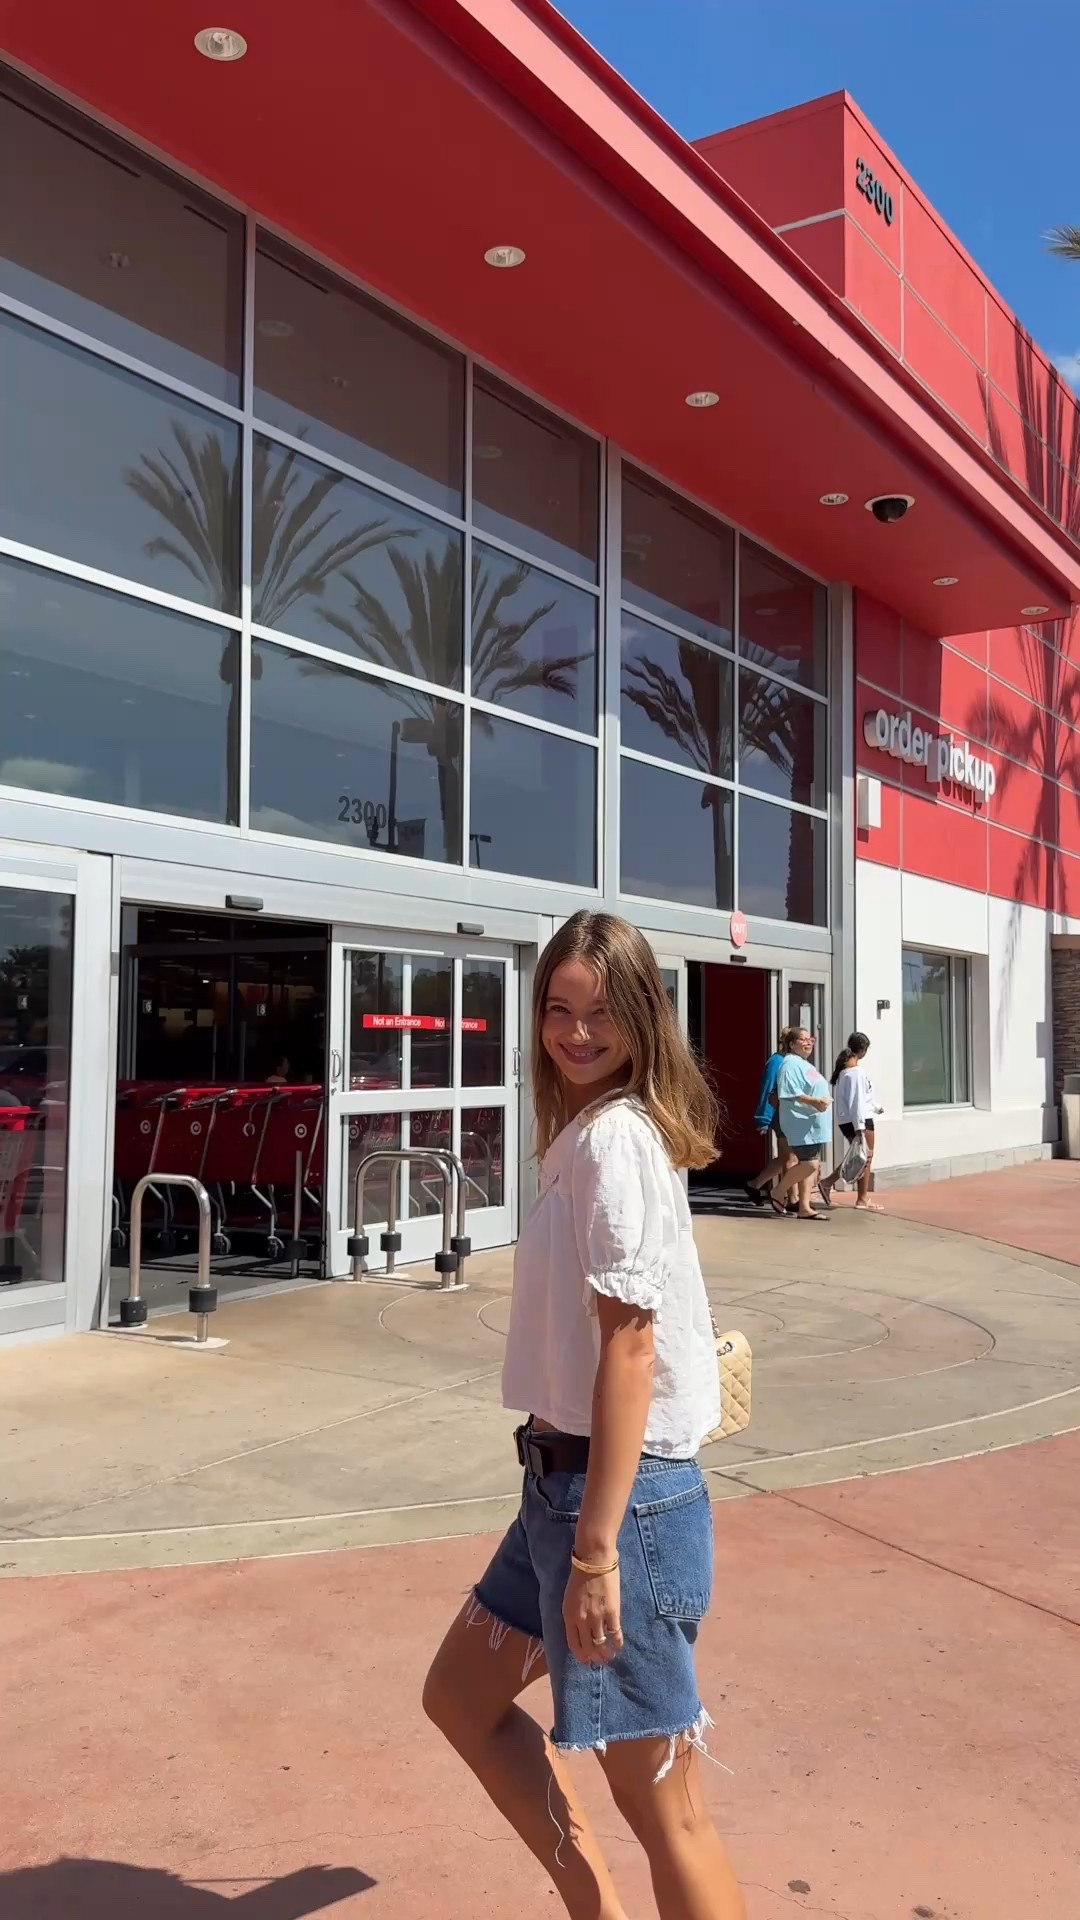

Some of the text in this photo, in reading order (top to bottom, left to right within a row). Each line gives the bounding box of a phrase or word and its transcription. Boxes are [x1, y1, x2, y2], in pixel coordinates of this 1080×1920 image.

[856, 156, 895, 226] 2300
[868, 708, 996, 802] order pickup
[337, 795, 387, 829] 2300
[732, 922, 746, 935] OUT
[372, 1016, 422, 1027] Not an Entrance
